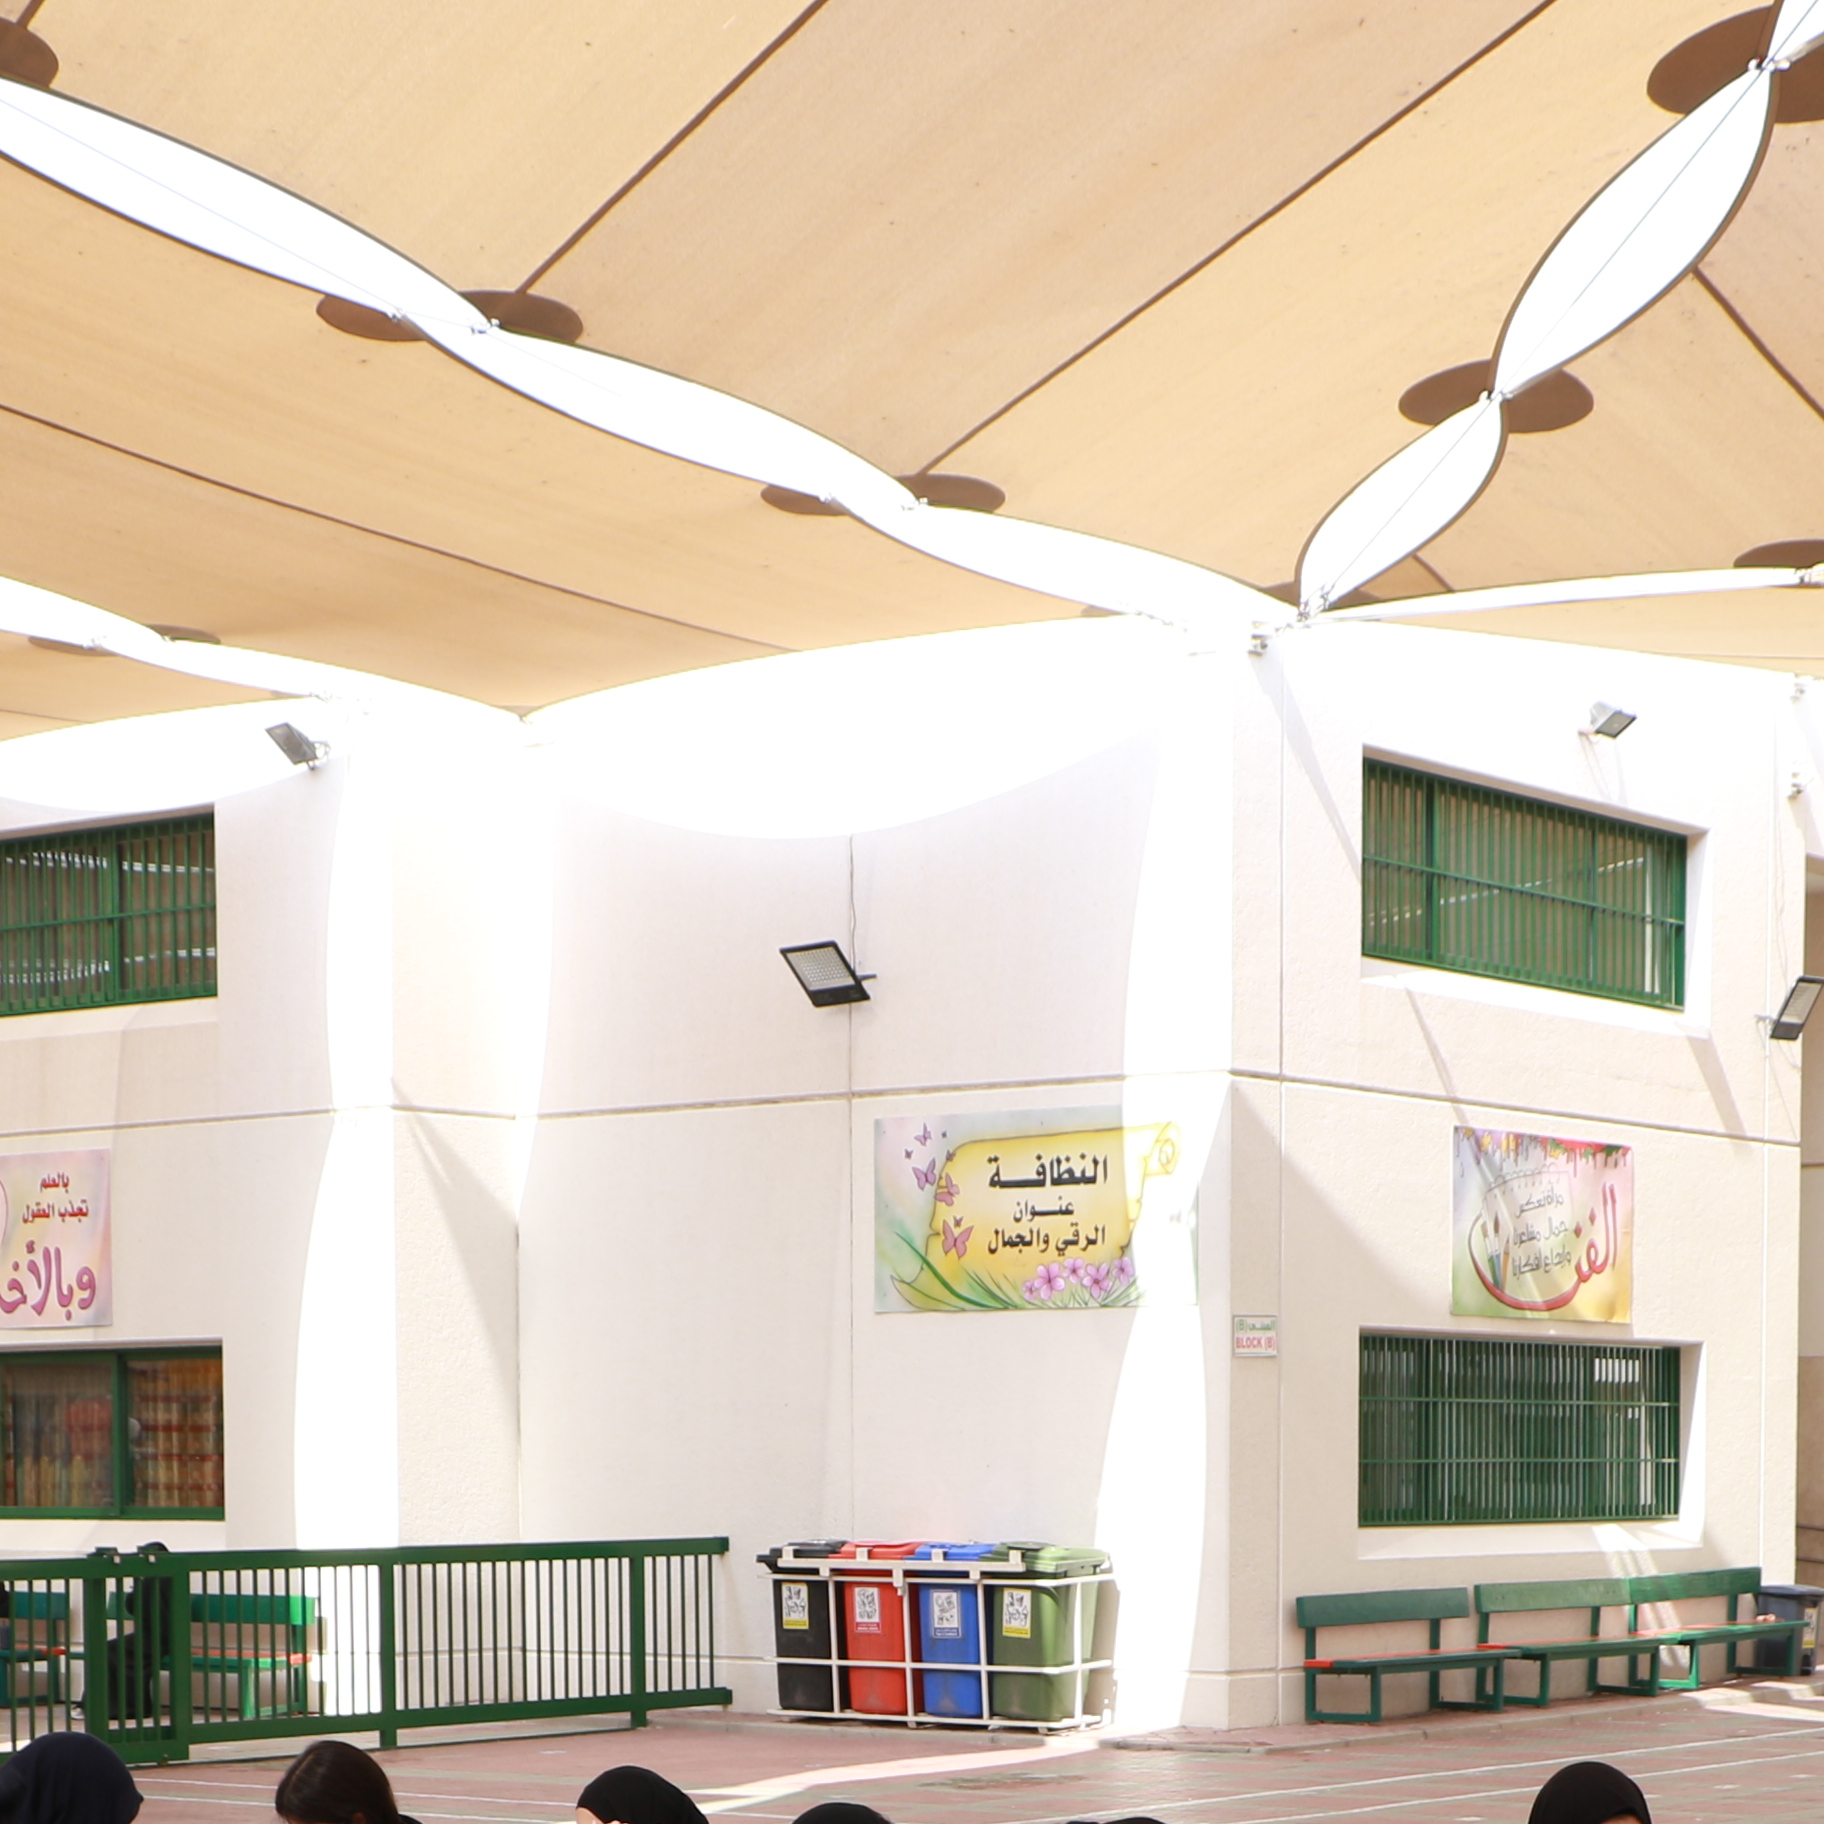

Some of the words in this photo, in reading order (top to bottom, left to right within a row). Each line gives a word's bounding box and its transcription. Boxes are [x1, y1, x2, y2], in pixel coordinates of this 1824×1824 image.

[39, 1171, 70, 1194] بالعلم
[986, 1152, 1109, 1190] النظافة
[22, 1201, 55, 1224] العقول
[57, 1199, 89, 1223] تجذب
[1013, 1195, 1075, 1223] عنوان
[987, 1226, 1050, 1255] والجمال
[1055, 1222, 1107, 1257] الرقي
[1469, 1182, 1617, 1312] الفن
[1236, 1336, 1264, 1349] BLOCK
[1264, 1335, 1277, 1351] (B)
